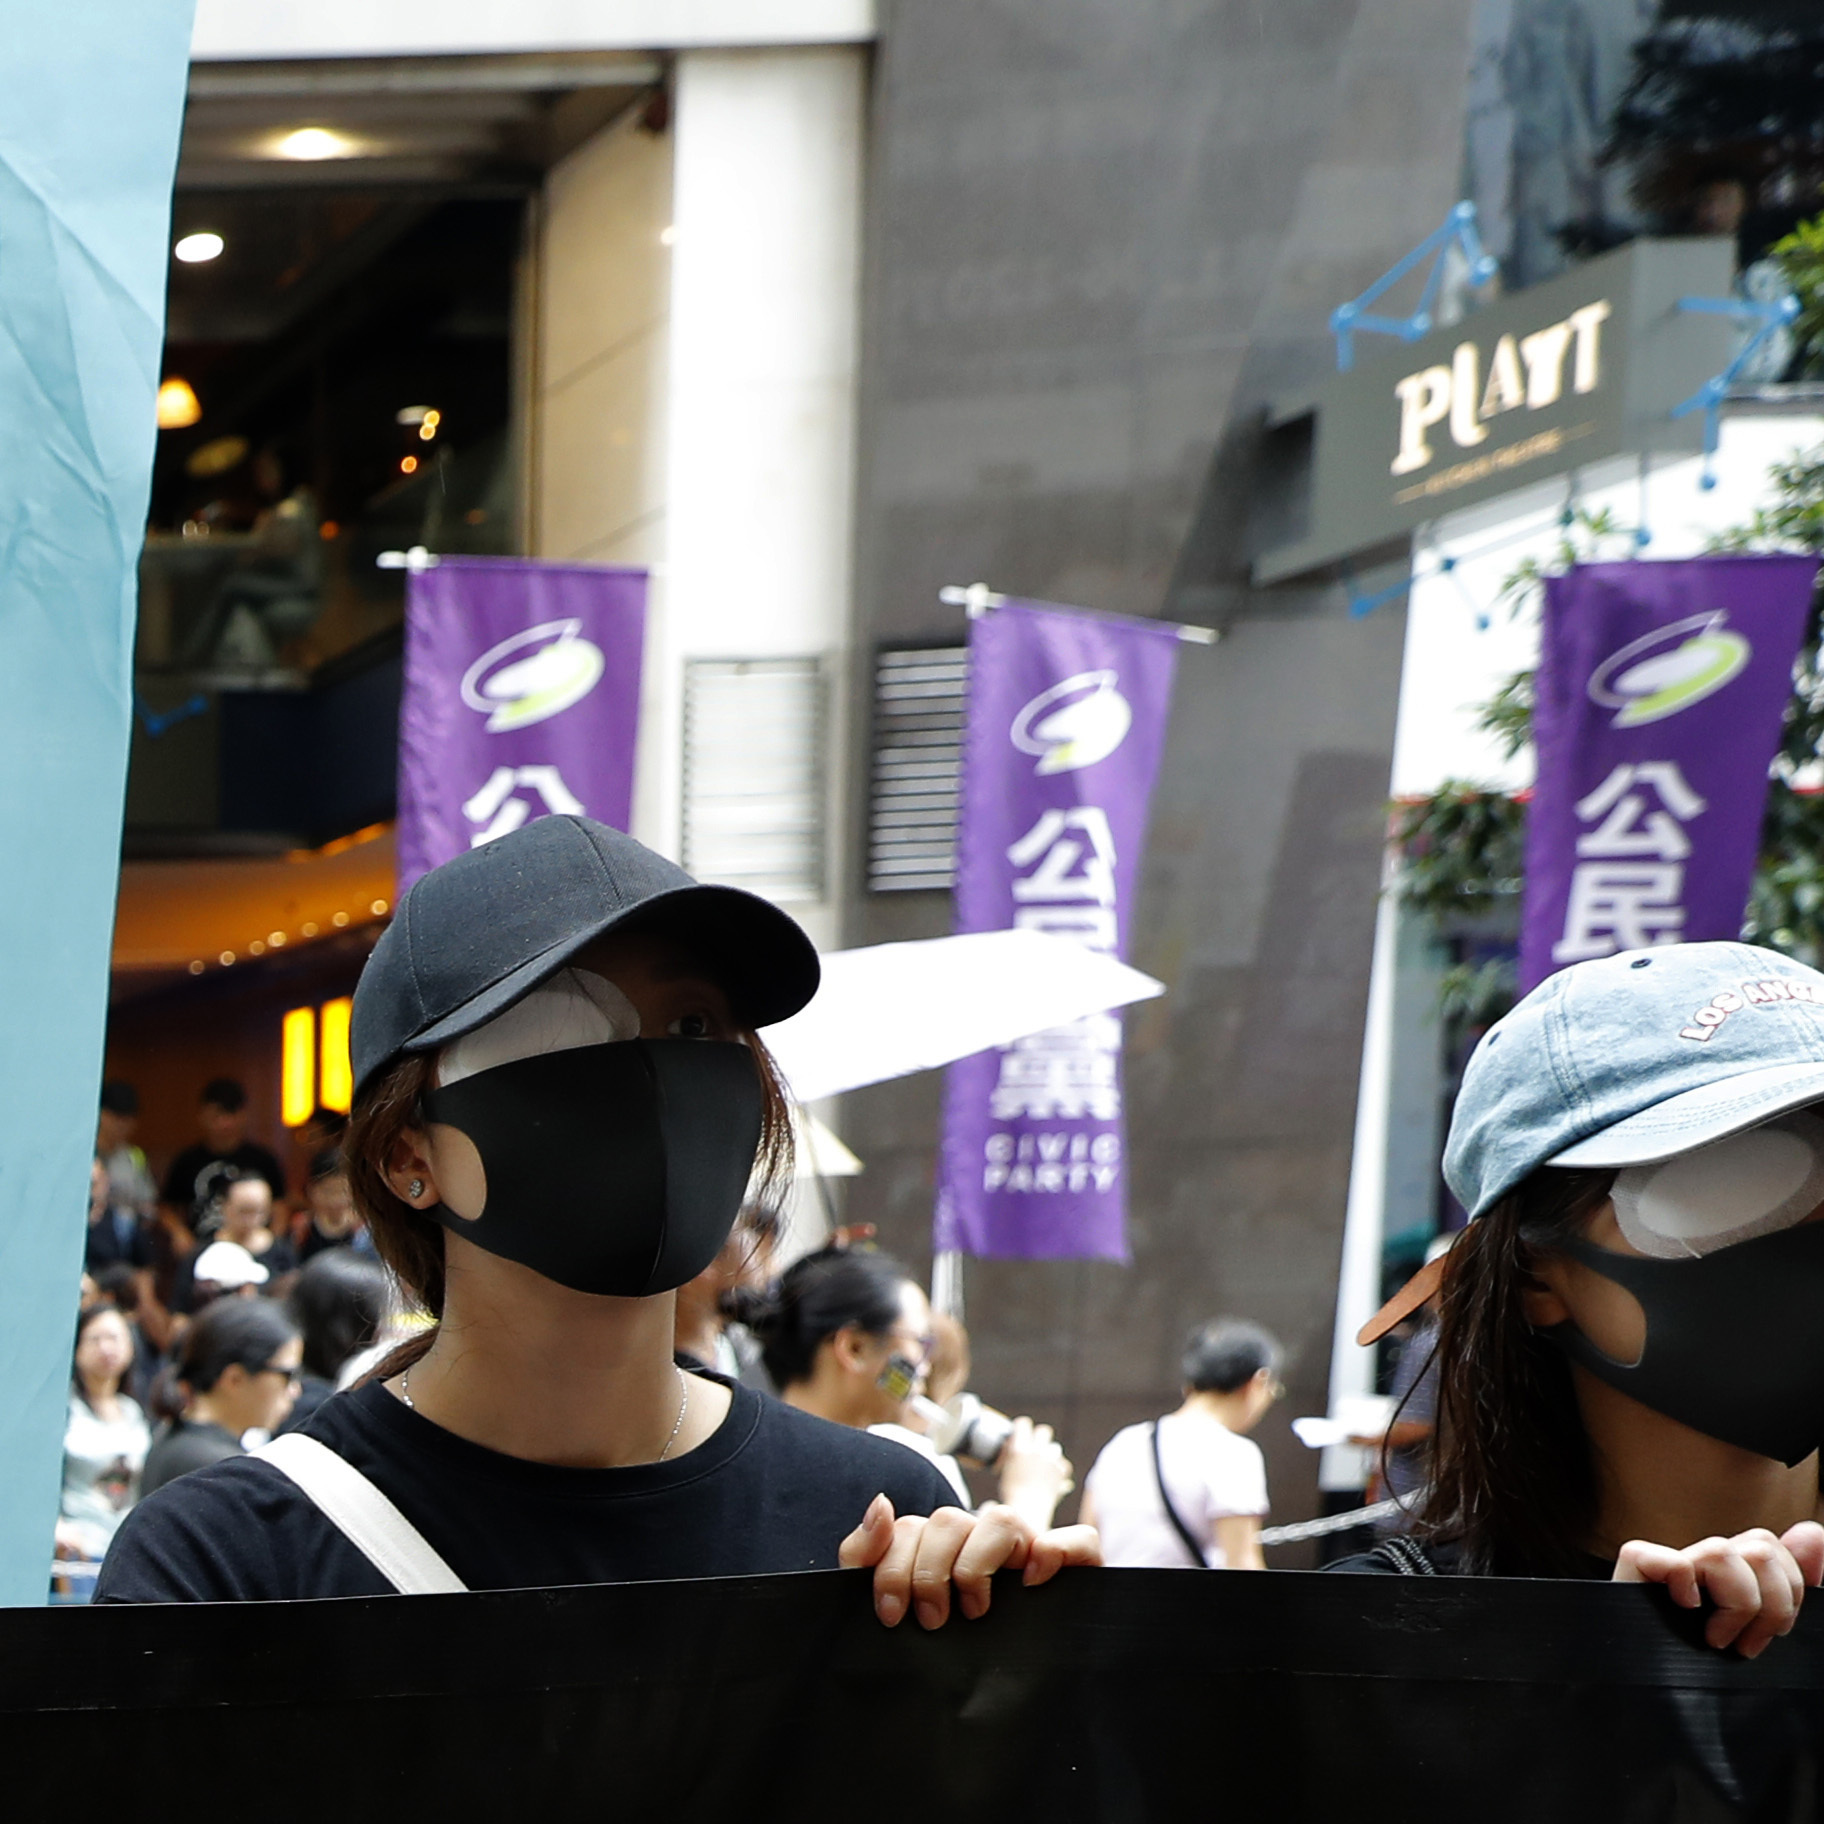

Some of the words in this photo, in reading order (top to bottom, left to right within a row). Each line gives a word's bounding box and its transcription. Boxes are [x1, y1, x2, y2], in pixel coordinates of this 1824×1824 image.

[1551, 761, 1708, 963] 公民
[1679, 992, 1744, 1042] LOS
[984, 1132, 1121, 1165] CIVIC
[983, 1162, 1120, 1194] PARTY
